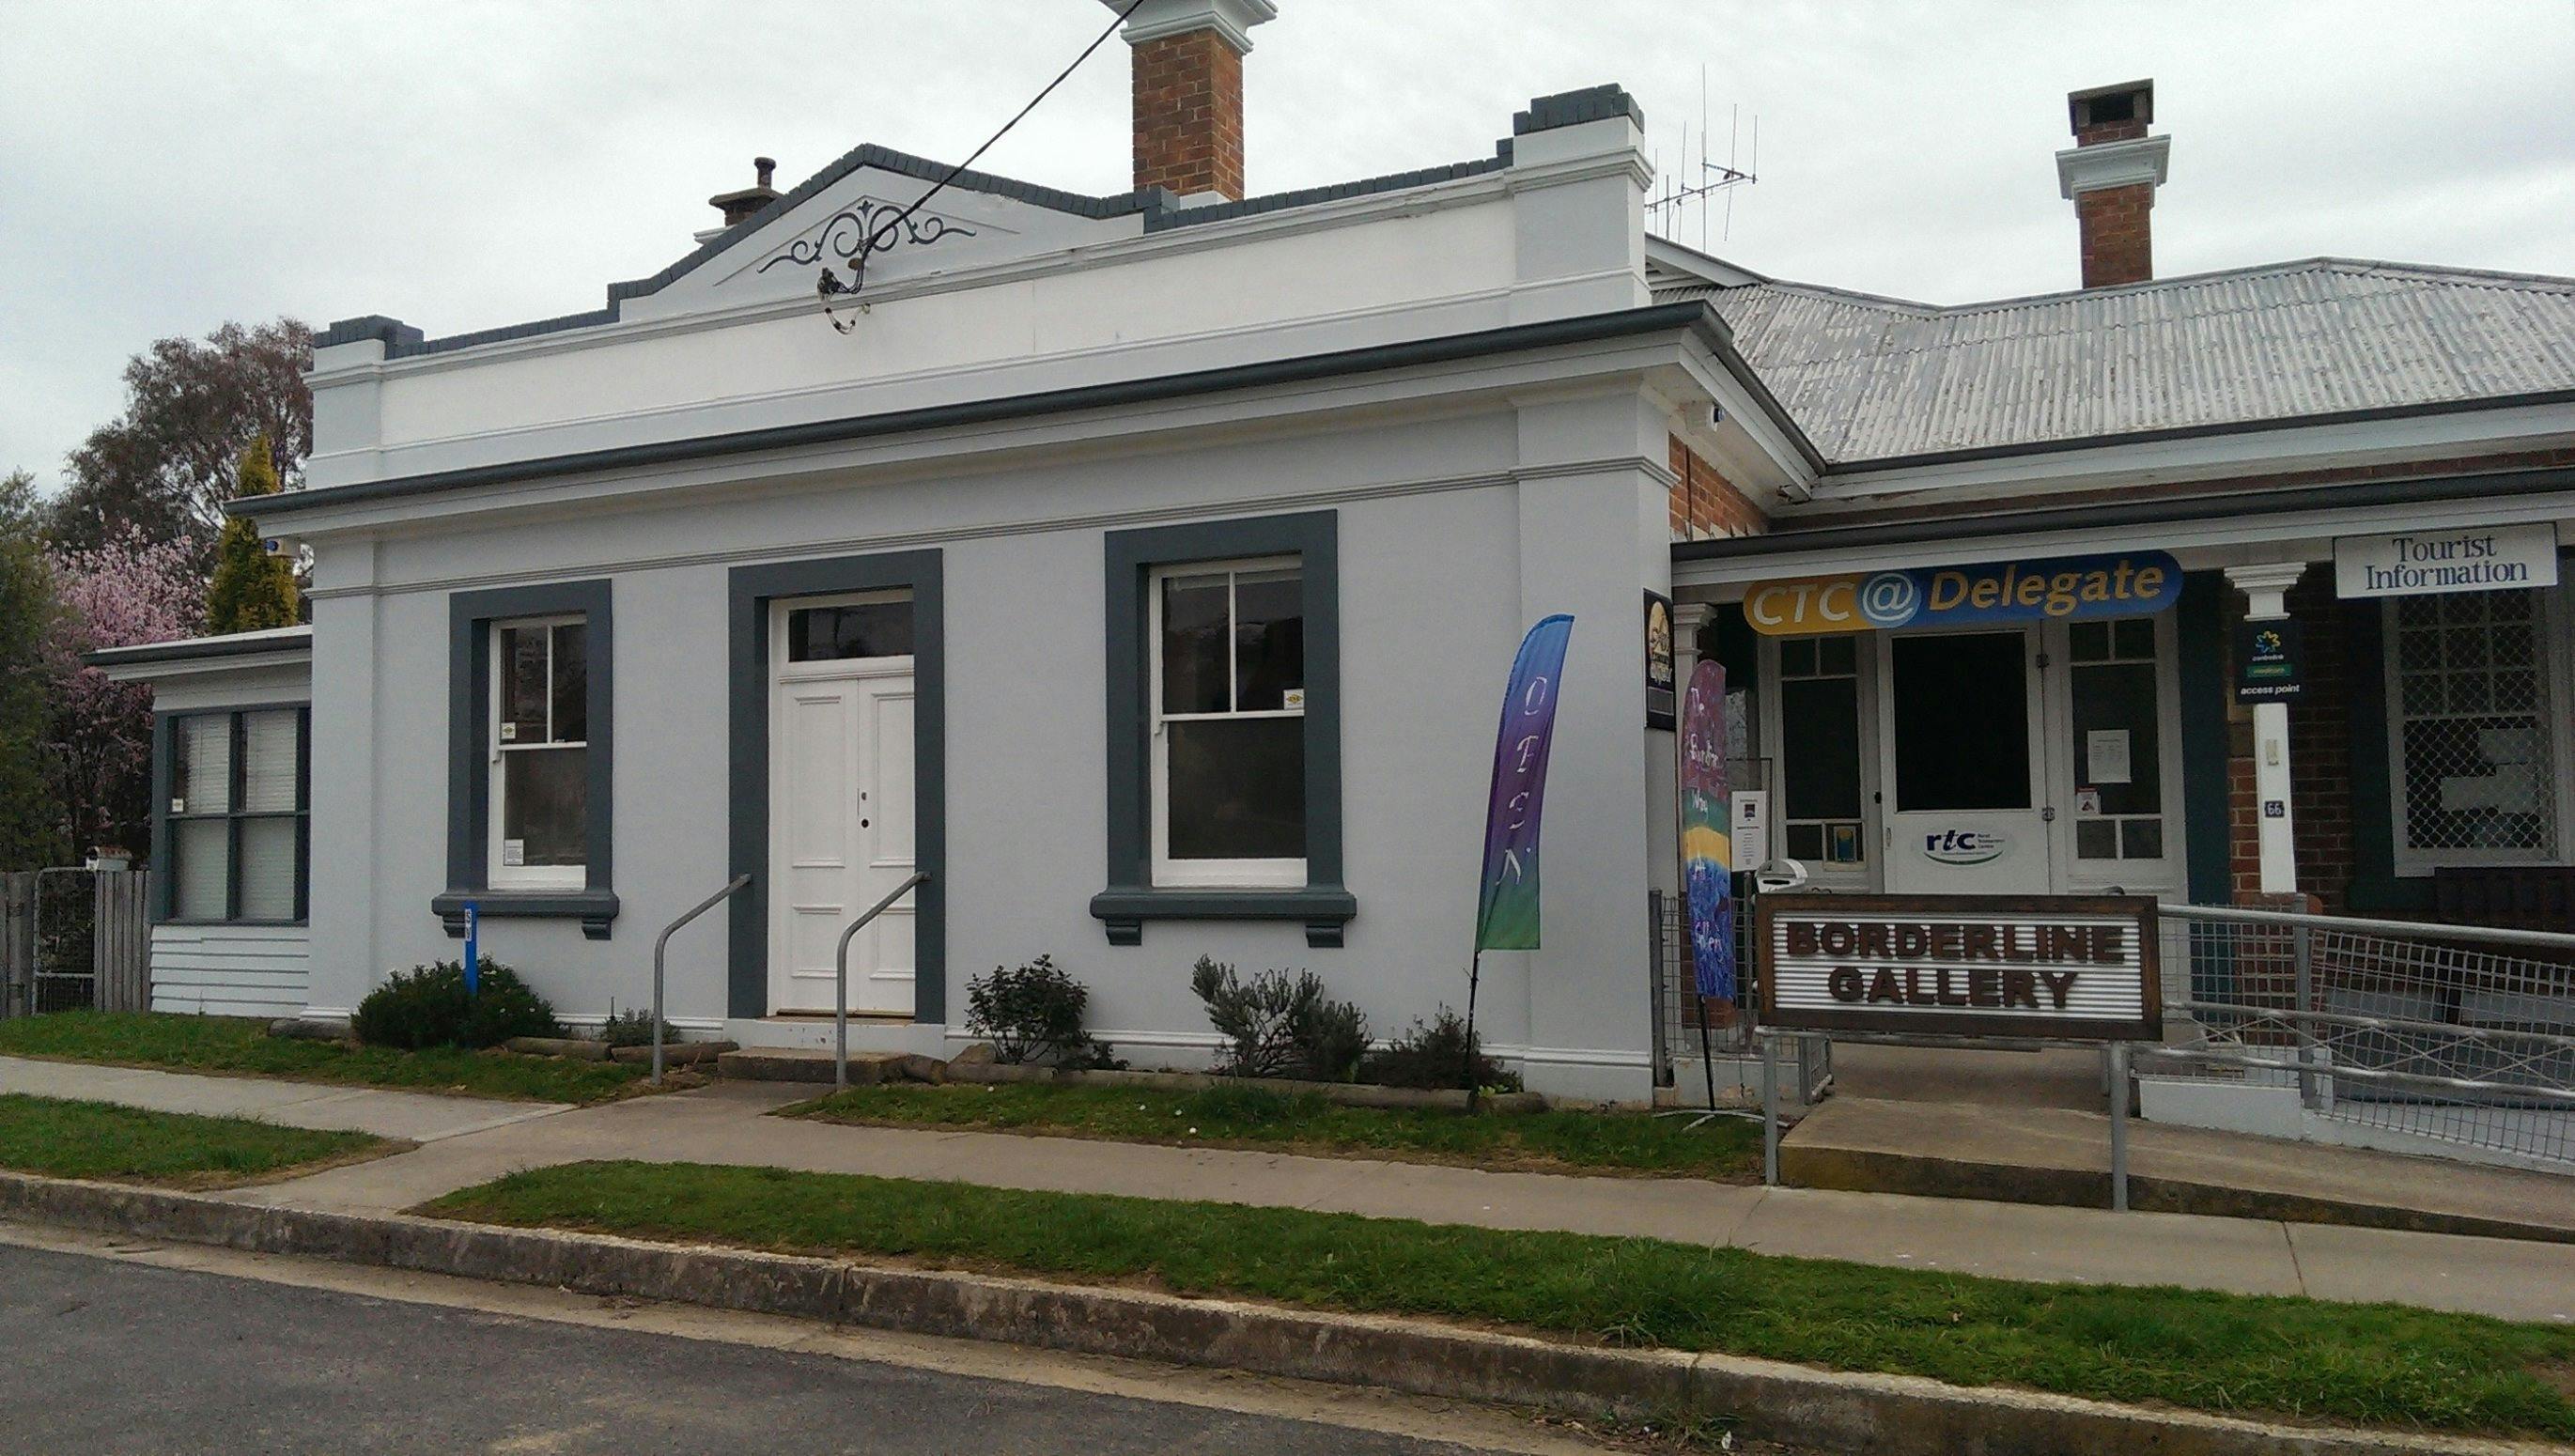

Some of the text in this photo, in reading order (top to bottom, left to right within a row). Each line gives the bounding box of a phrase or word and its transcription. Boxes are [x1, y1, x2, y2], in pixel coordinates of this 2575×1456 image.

[2392, 534, 2498, 563] Tourist
[2365, 560, 2528, 590] Information
[1753, 559, 2165, 626] CTC @ Delegate
[2241, 684, 2301, 695] access point
[2267, 802, 2282, 815] 66
[1927, 829, 1977, 851] rtc
[1786, 922, 2126, 963] BORDERLINE
[1827, 966, 2079, 1009] GALLERY
